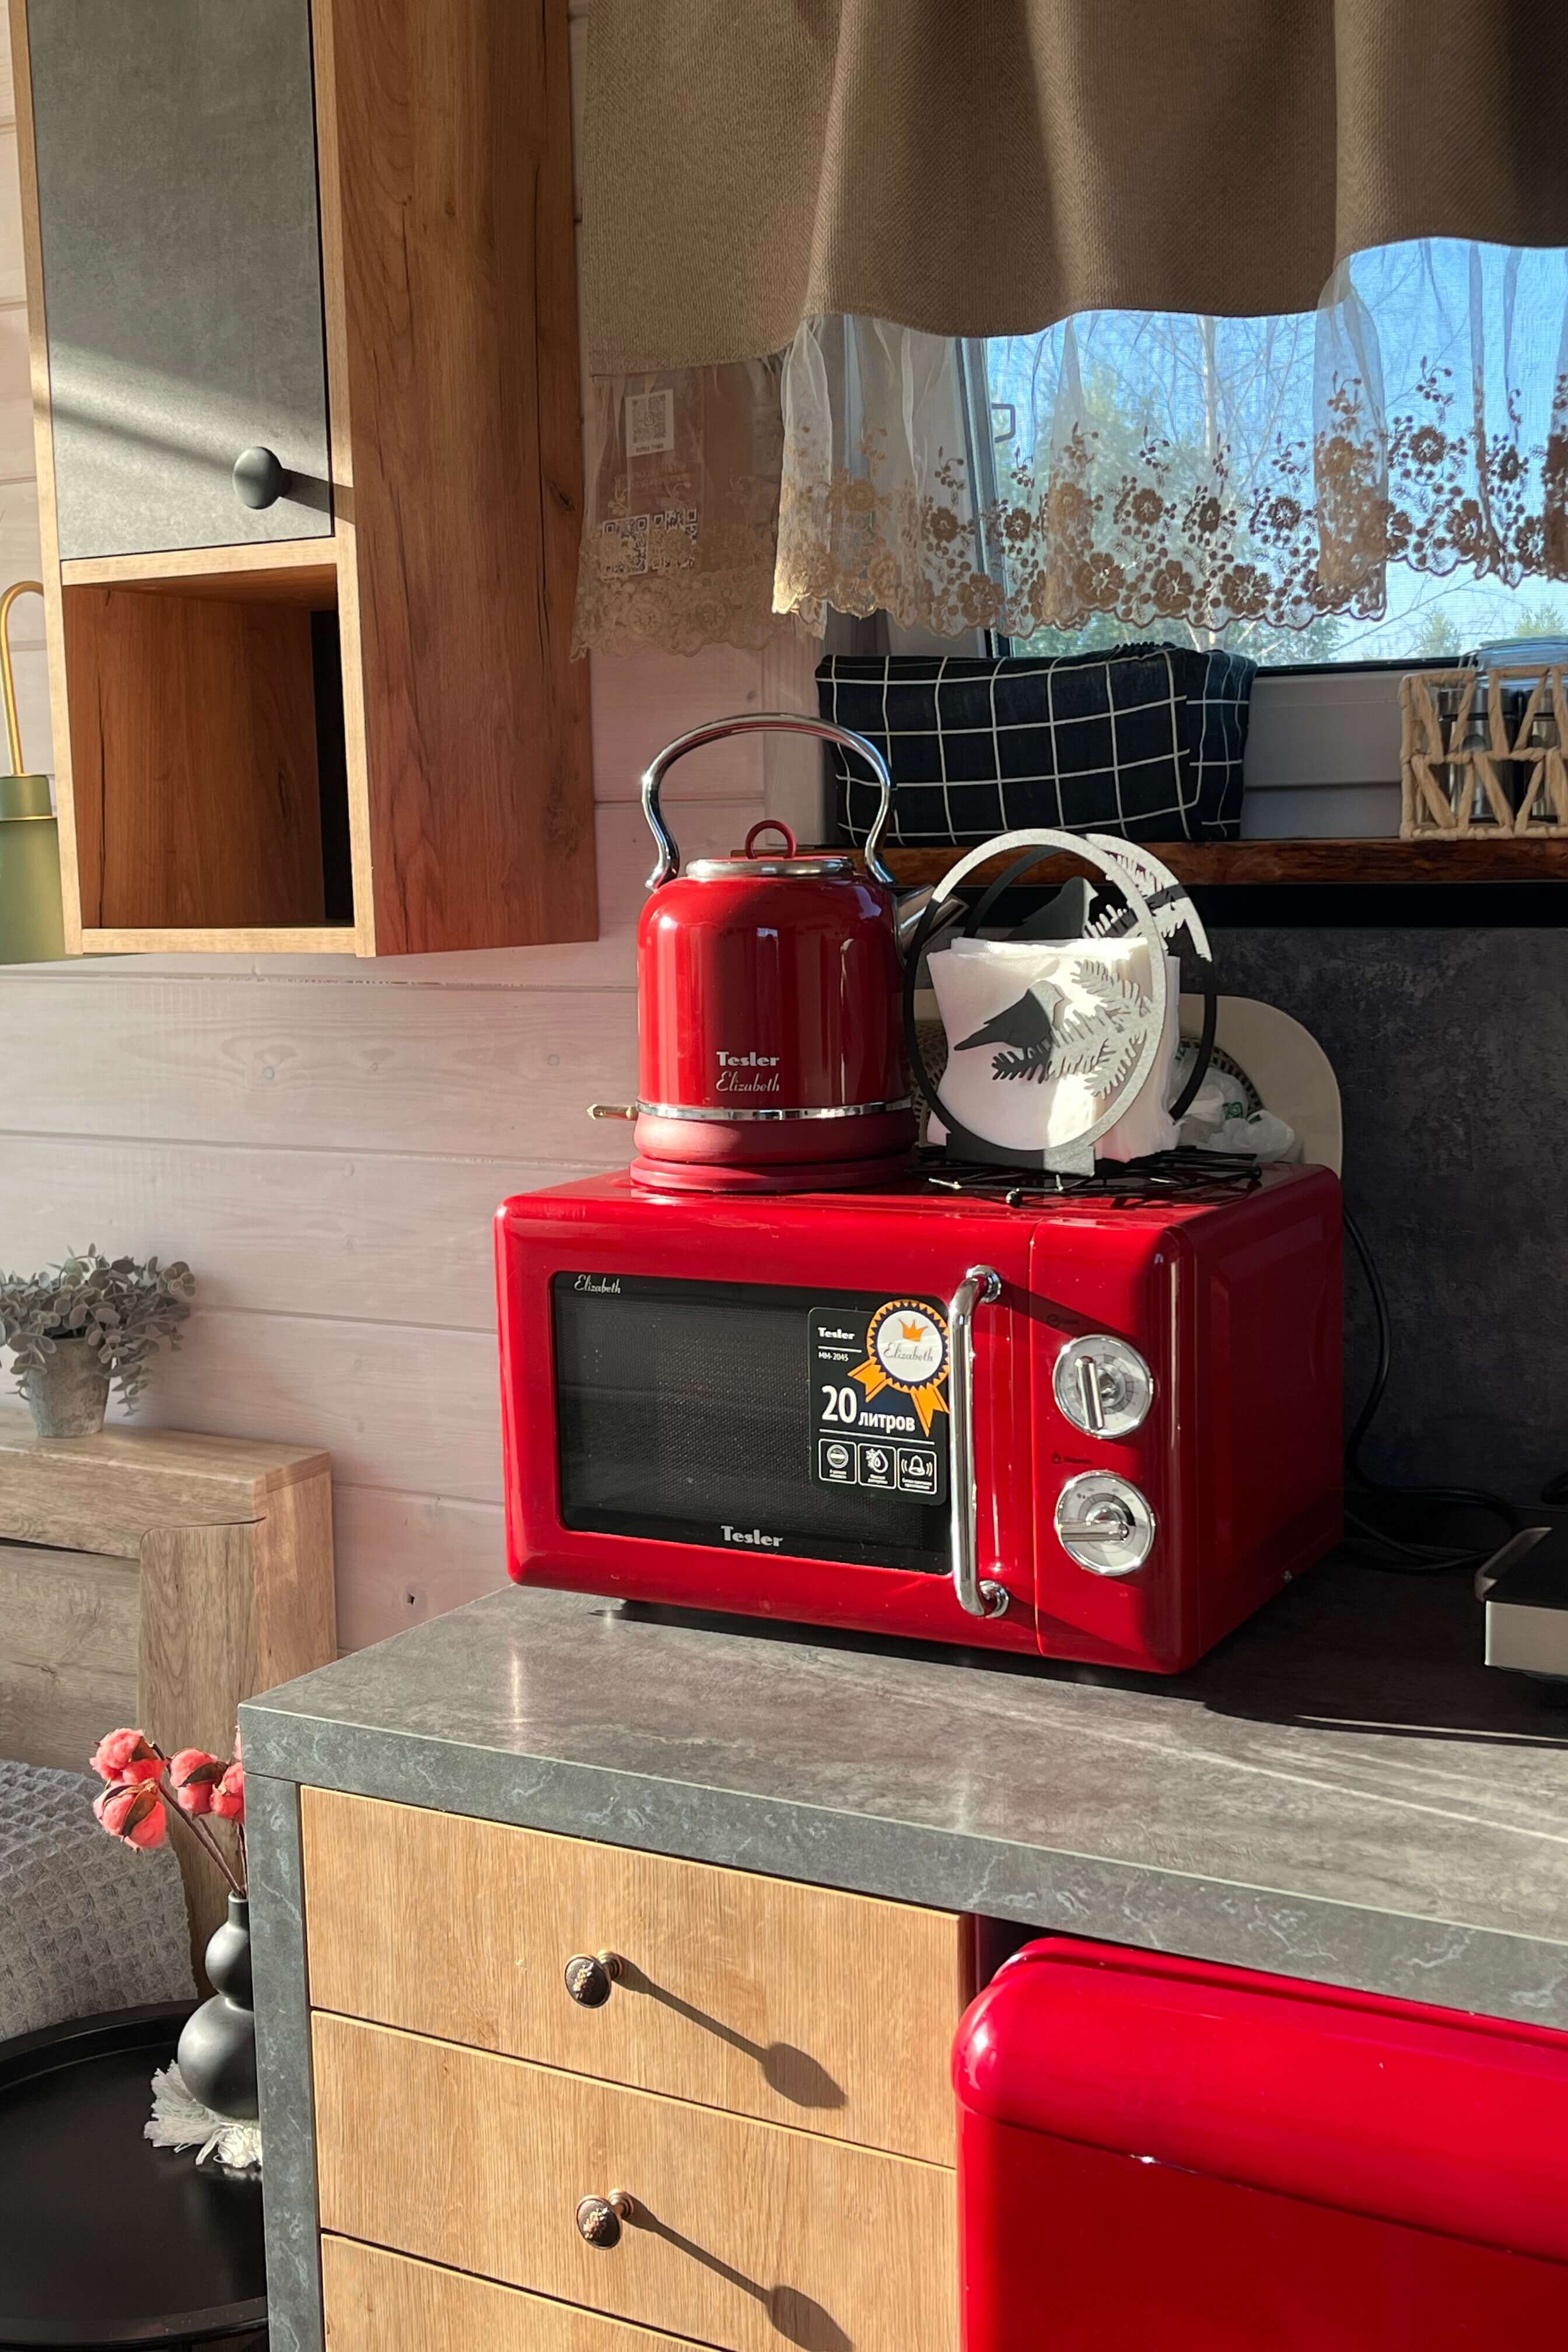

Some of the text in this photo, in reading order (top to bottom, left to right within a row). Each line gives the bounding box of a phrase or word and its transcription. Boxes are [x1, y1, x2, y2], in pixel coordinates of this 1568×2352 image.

[716, 1051, 779, 1066] Tesler
[716, 1070, 779, 1092] Elizabeth
[574, 1274, 621, 1294] Elizabeth
[817, 1326, 855, 1340] Tesler
[883, 1342, 933, 1362] Elizabeth
[821, 1385, 915, 1433] 20 литров
[720, 1525, 783, 1546] Tesler
